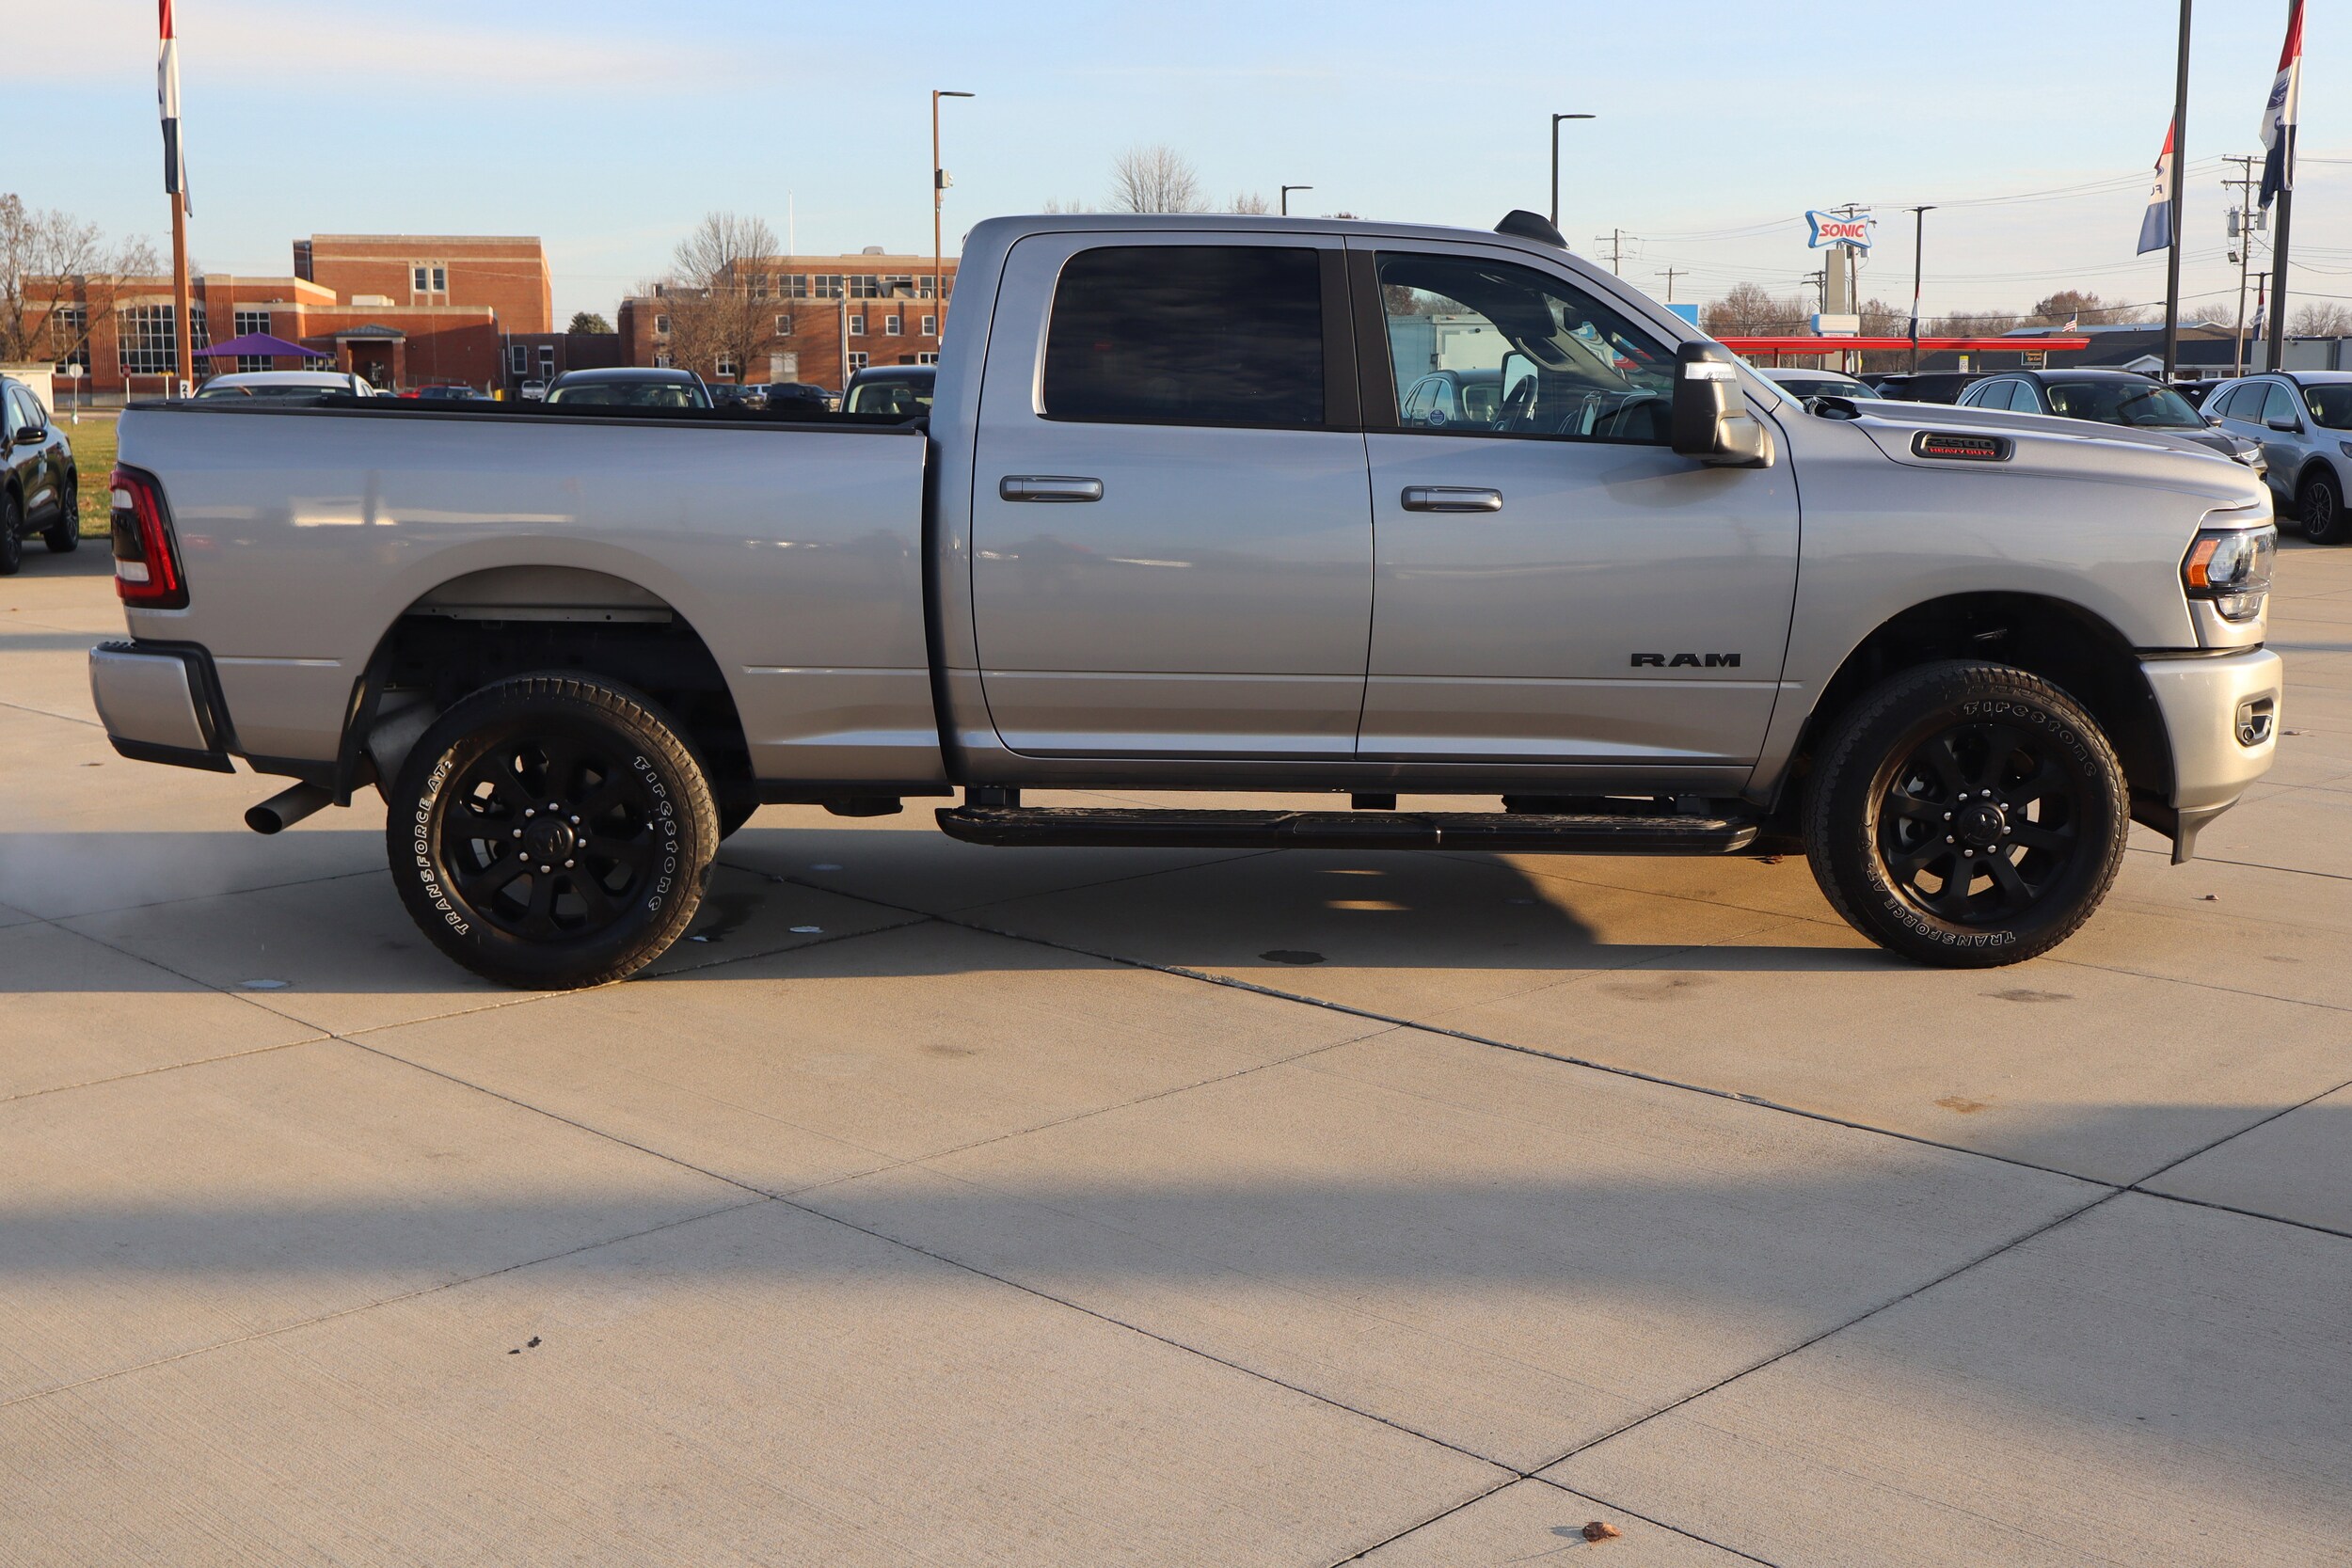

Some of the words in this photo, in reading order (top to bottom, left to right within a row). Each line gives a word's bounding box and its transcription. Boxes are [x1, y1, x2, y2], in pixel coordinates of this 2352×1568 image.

[1819, 224, 1865, 237] SONIC
[1927, 437, 1994, 450] 2500
[1630, 653, 1741, 667] RAM
[633, 755, 679, 911] Firestone
[414, 798, 469, 936] TRANSFORCE
[1883, 898, 2016, 947] TRANSFORCE
